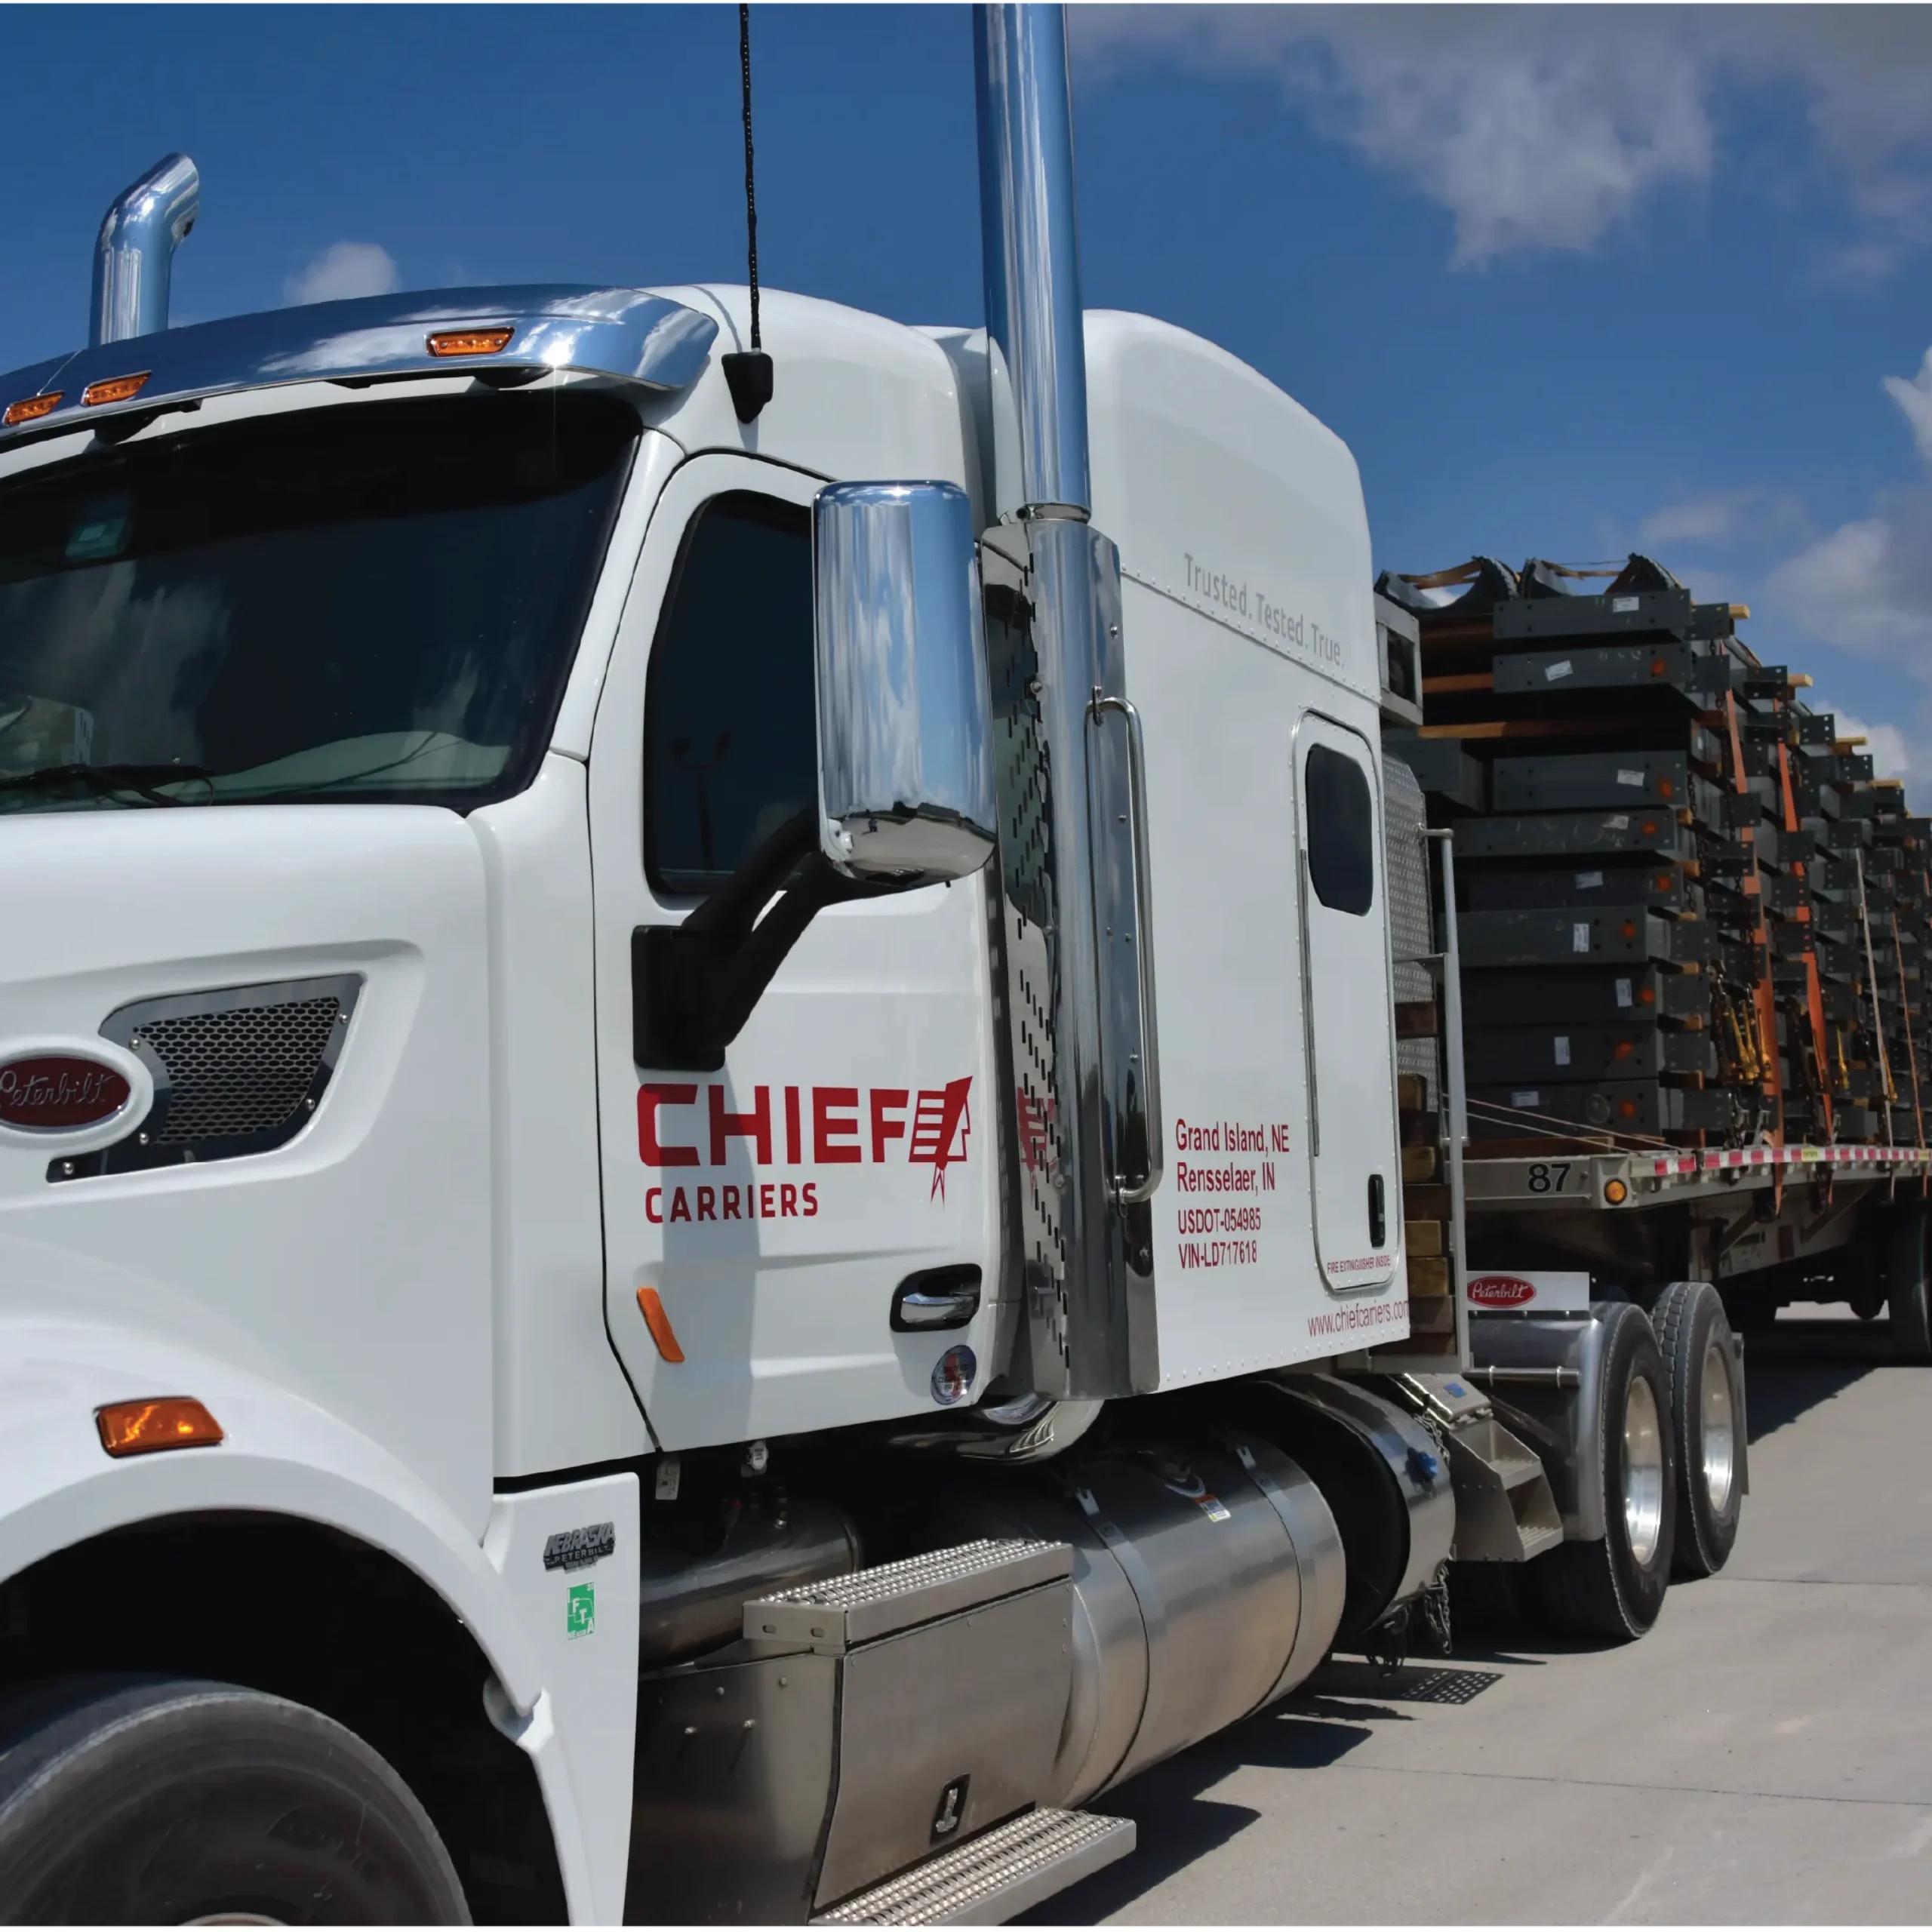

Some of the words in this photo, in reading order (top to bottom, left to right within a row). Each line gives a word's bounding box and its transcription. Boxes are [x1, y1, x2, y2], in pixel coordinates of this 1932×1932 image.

[1184, 552, 1253, 620] Trusted.
[1256, 592, 1309, 650] Tested.
[1311, 623, 1345, 669] True.
[0, 1069, 116, 1106] Peterbilt
[637, 1083, 910, 1167] CHIEF
[1176, 1118, 1220, 1152] Grand
[1224, 1121, 1269, 1157] Island,
[1272, 1124, 1290, 1153] NE
[1177, 1161, 1259, 1196] Rensselaer,
[1262, 1162, 1275, 1191] IN
[1527, 1162, 1571, 1193] 87
[645, 1183, 818, 1224] CARRIERS
[1177, 1208, 1262, 1235] USDOT-054985
[1178, 1240, 1258, 1269] VIN-LD717618
[1327, 1261, 1340, 1274] FIRE
[1340, 1257, 1375, 1273] EXTINGUISHER
[1375, 1254, 1391, 1268] INSIDE
[1472, 1281, 1529, 1300] Peterbilt
[543, 1521, 616, 1557] NEBRASKA
[555, 1546, 611, 1563] PETERBILT
